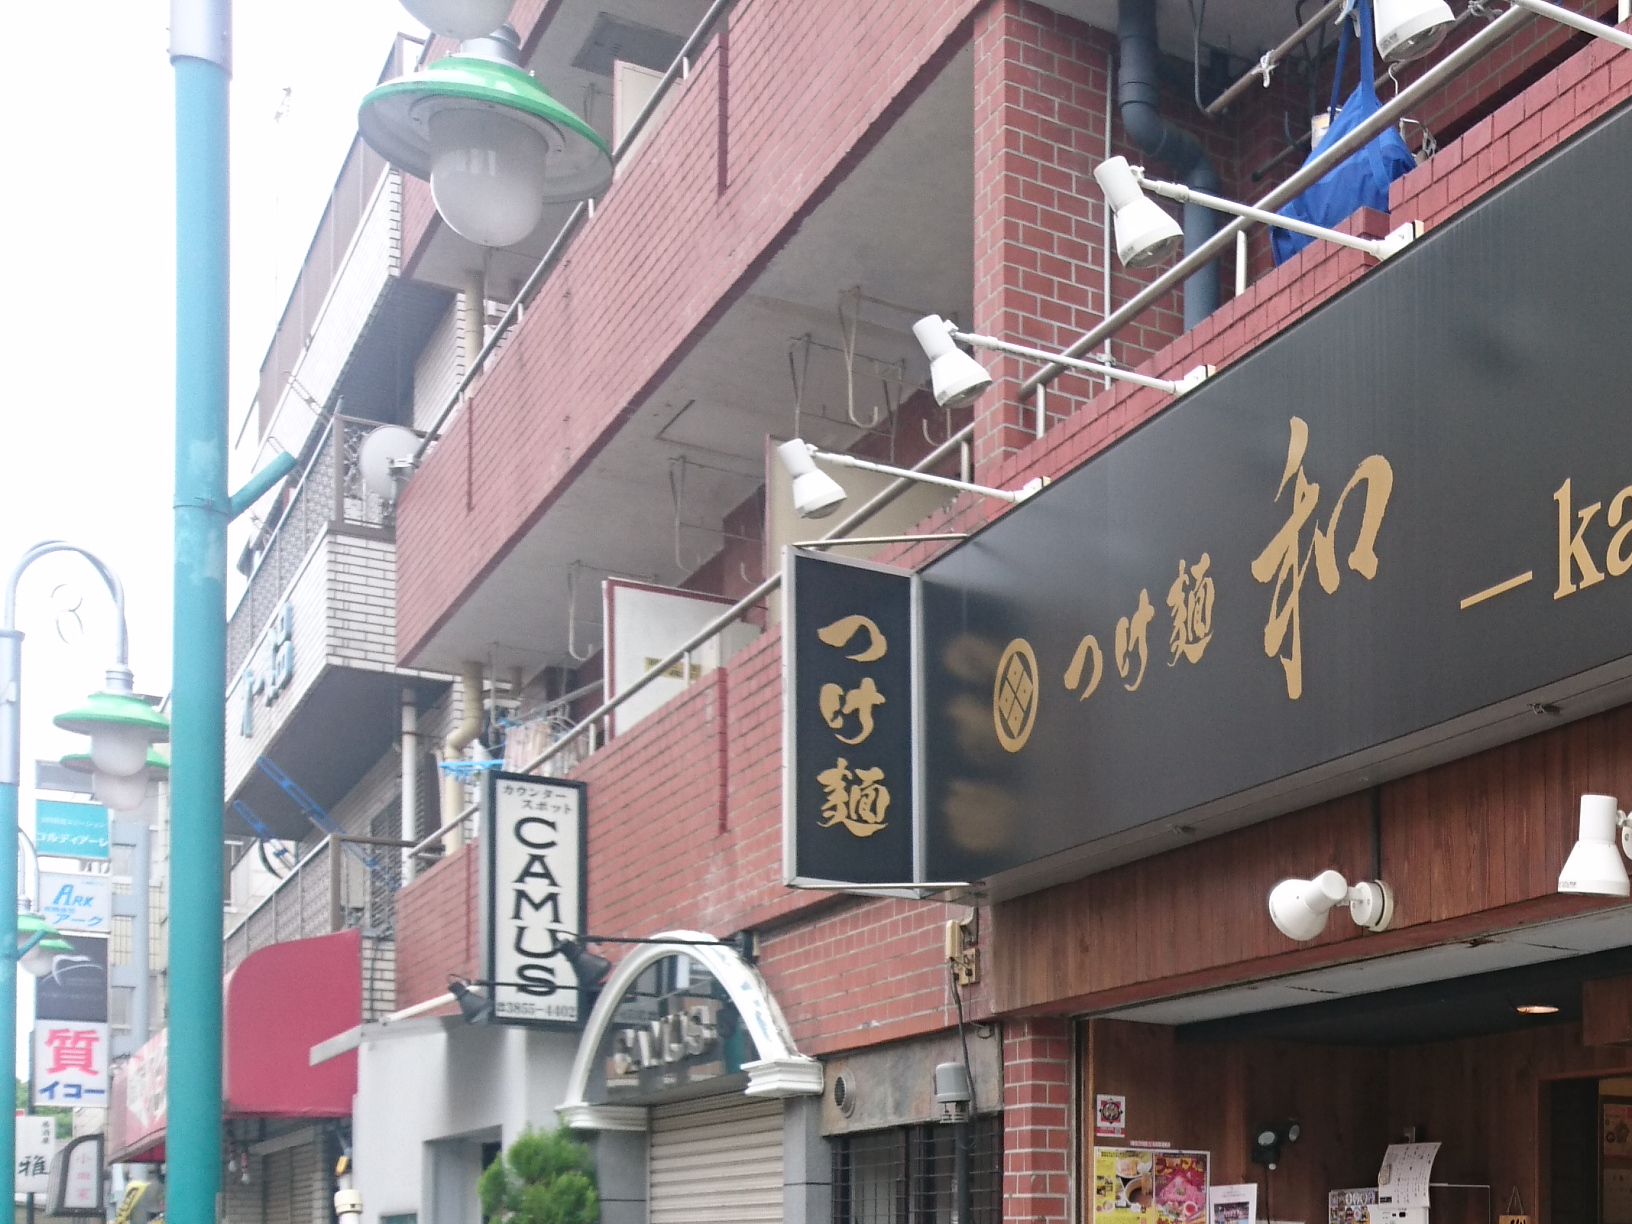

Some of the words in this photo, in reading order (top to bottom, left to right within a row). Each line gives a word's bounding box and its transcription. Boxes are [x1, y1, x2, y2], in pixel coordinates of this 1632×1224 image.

[1063, 551, 1216, 703] つけ麺
[1251, 415, 1394, 701] 和
[816, 614, 891, 838] つけ麺
[502, 784, 568, 799] カウンター
[52, 913, 104, 928] アーク
[511, 816, 562, 997] CAMUS
[45, 1028, 101, 1077] 質
[39, 1080, 106, 1100] イコー
